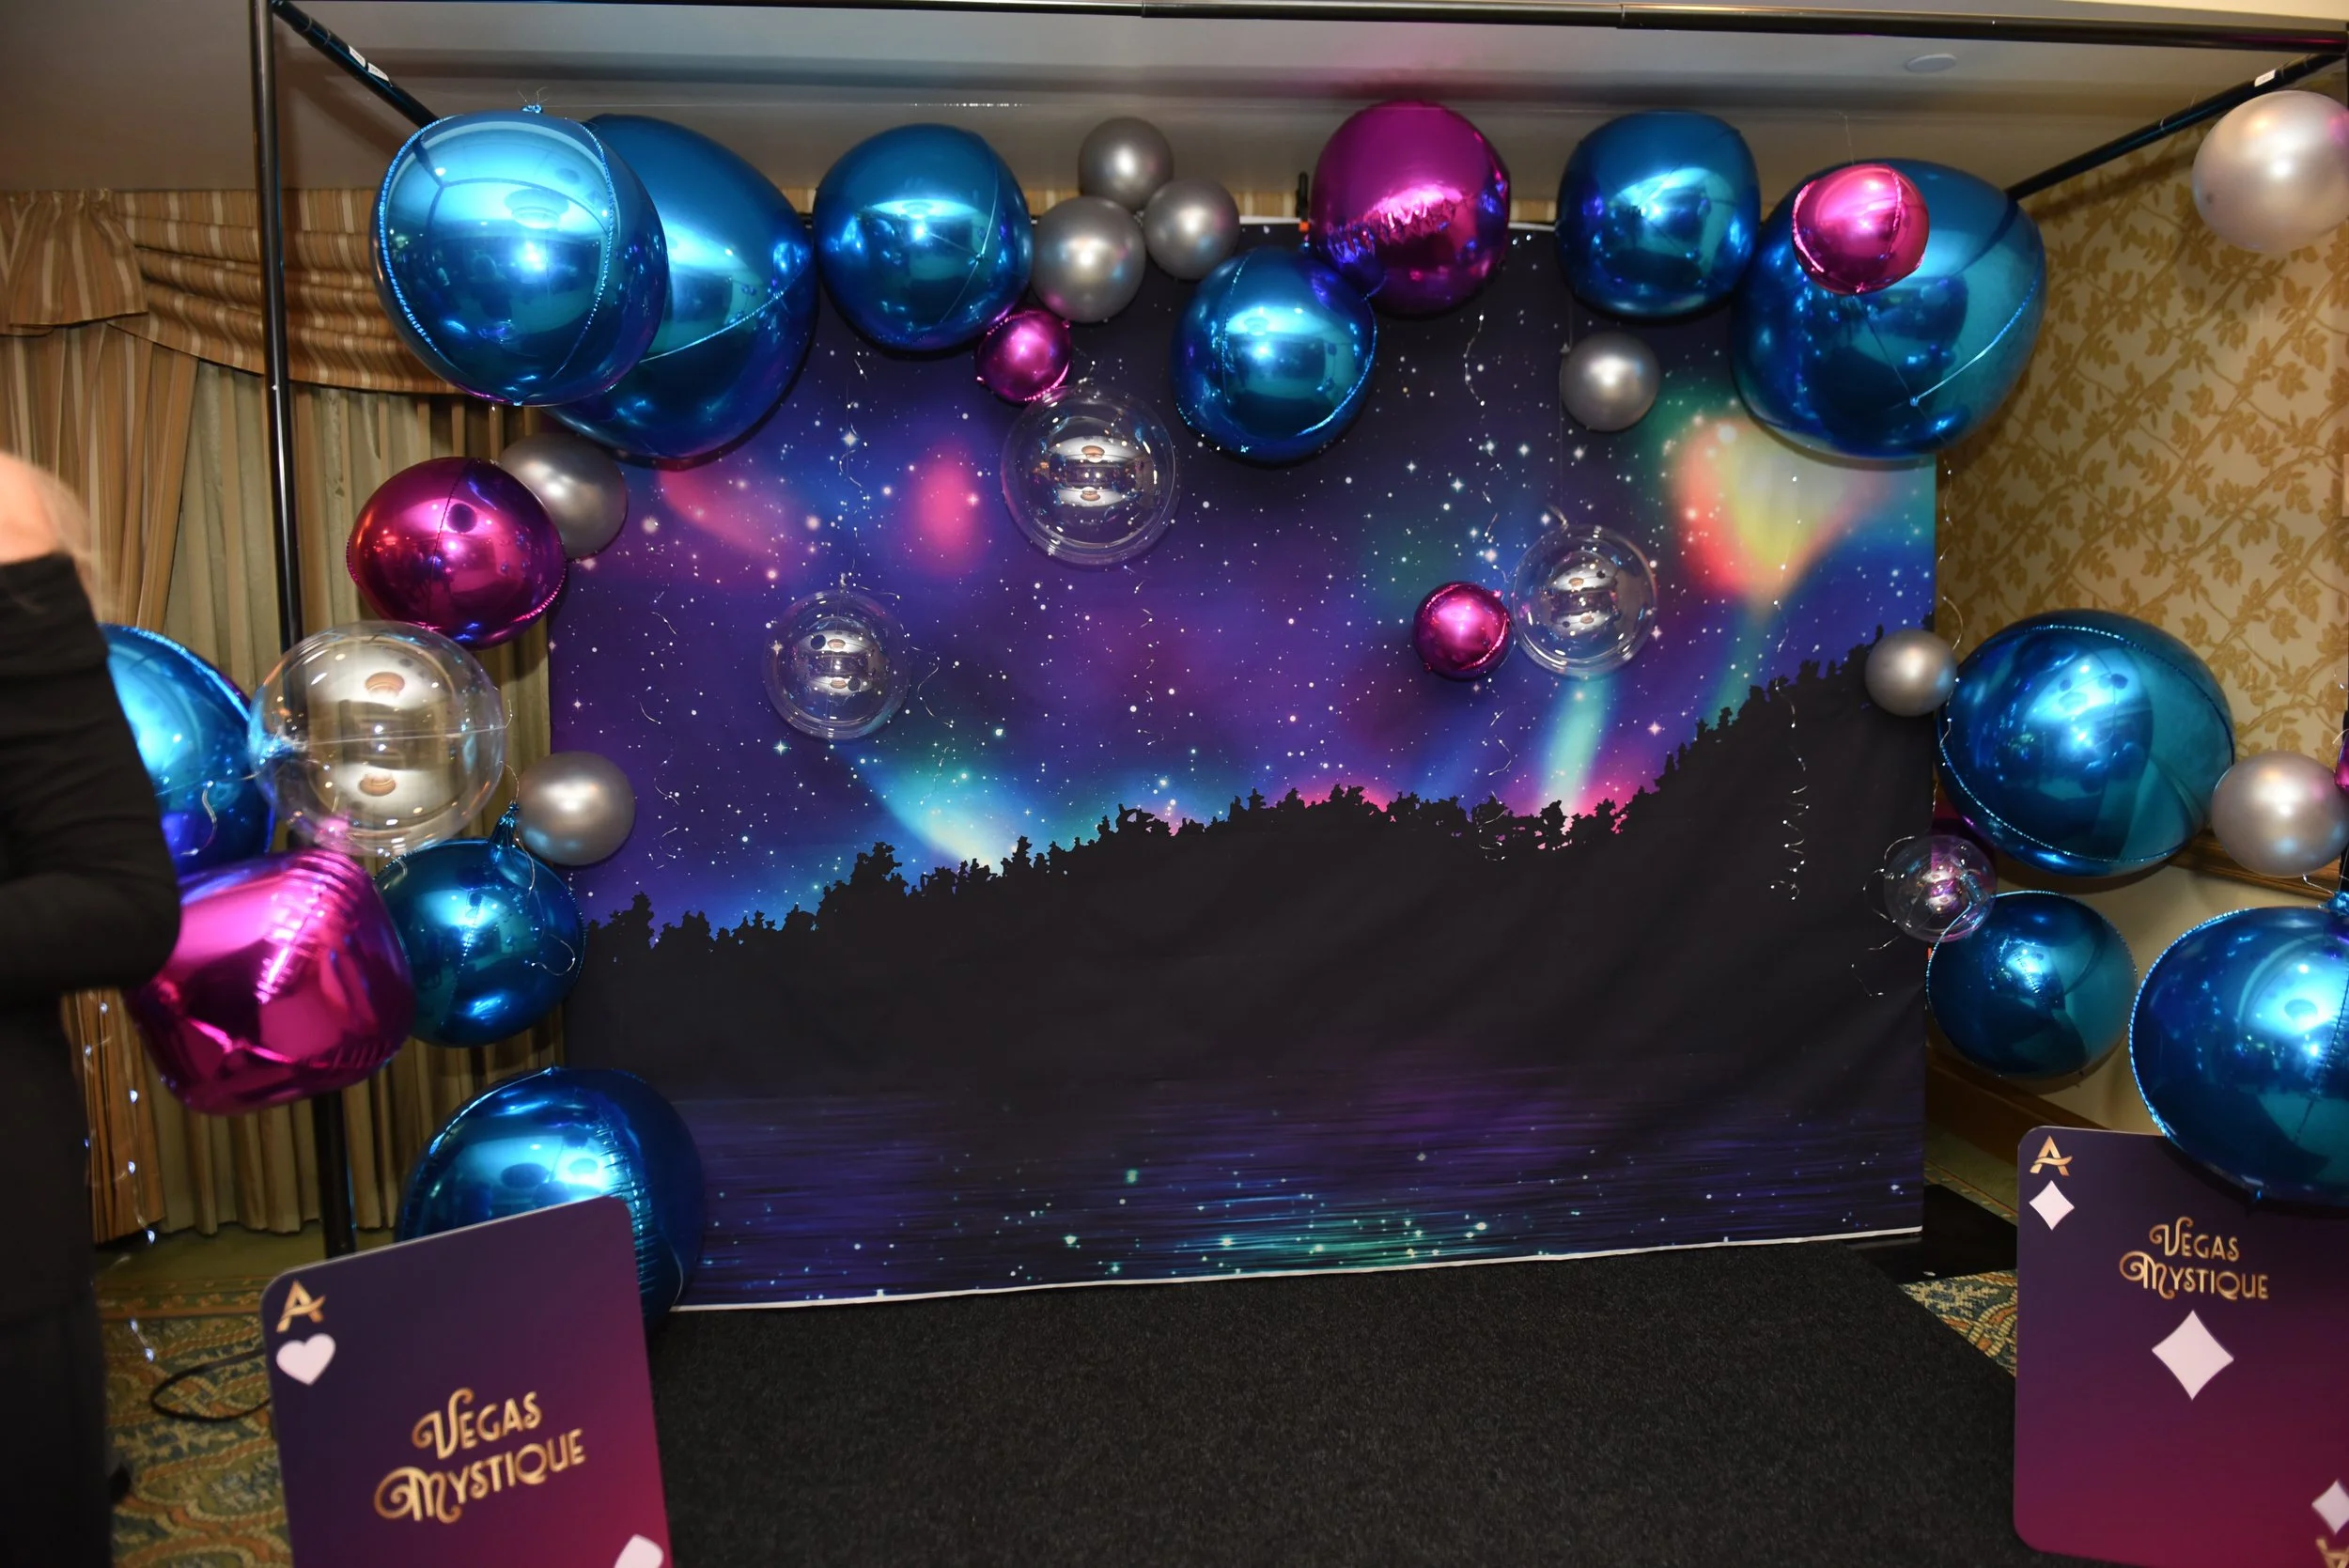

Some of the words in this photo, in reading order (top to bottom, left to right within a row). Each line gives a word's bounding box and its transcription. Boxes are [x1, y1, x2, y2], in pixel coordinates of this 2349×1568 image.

[2030, 1136, 2073, 1176] A
[2149, 1217, 2240, 1262] VEGAS
[2119, 1250, 2269, 1300] MYSTIQUE
[276, 1280, 326, 1332] A
[412, 1388, 542, 1460] VEGAS
[374, 1428, 587, 1525] MYSTIQUE
